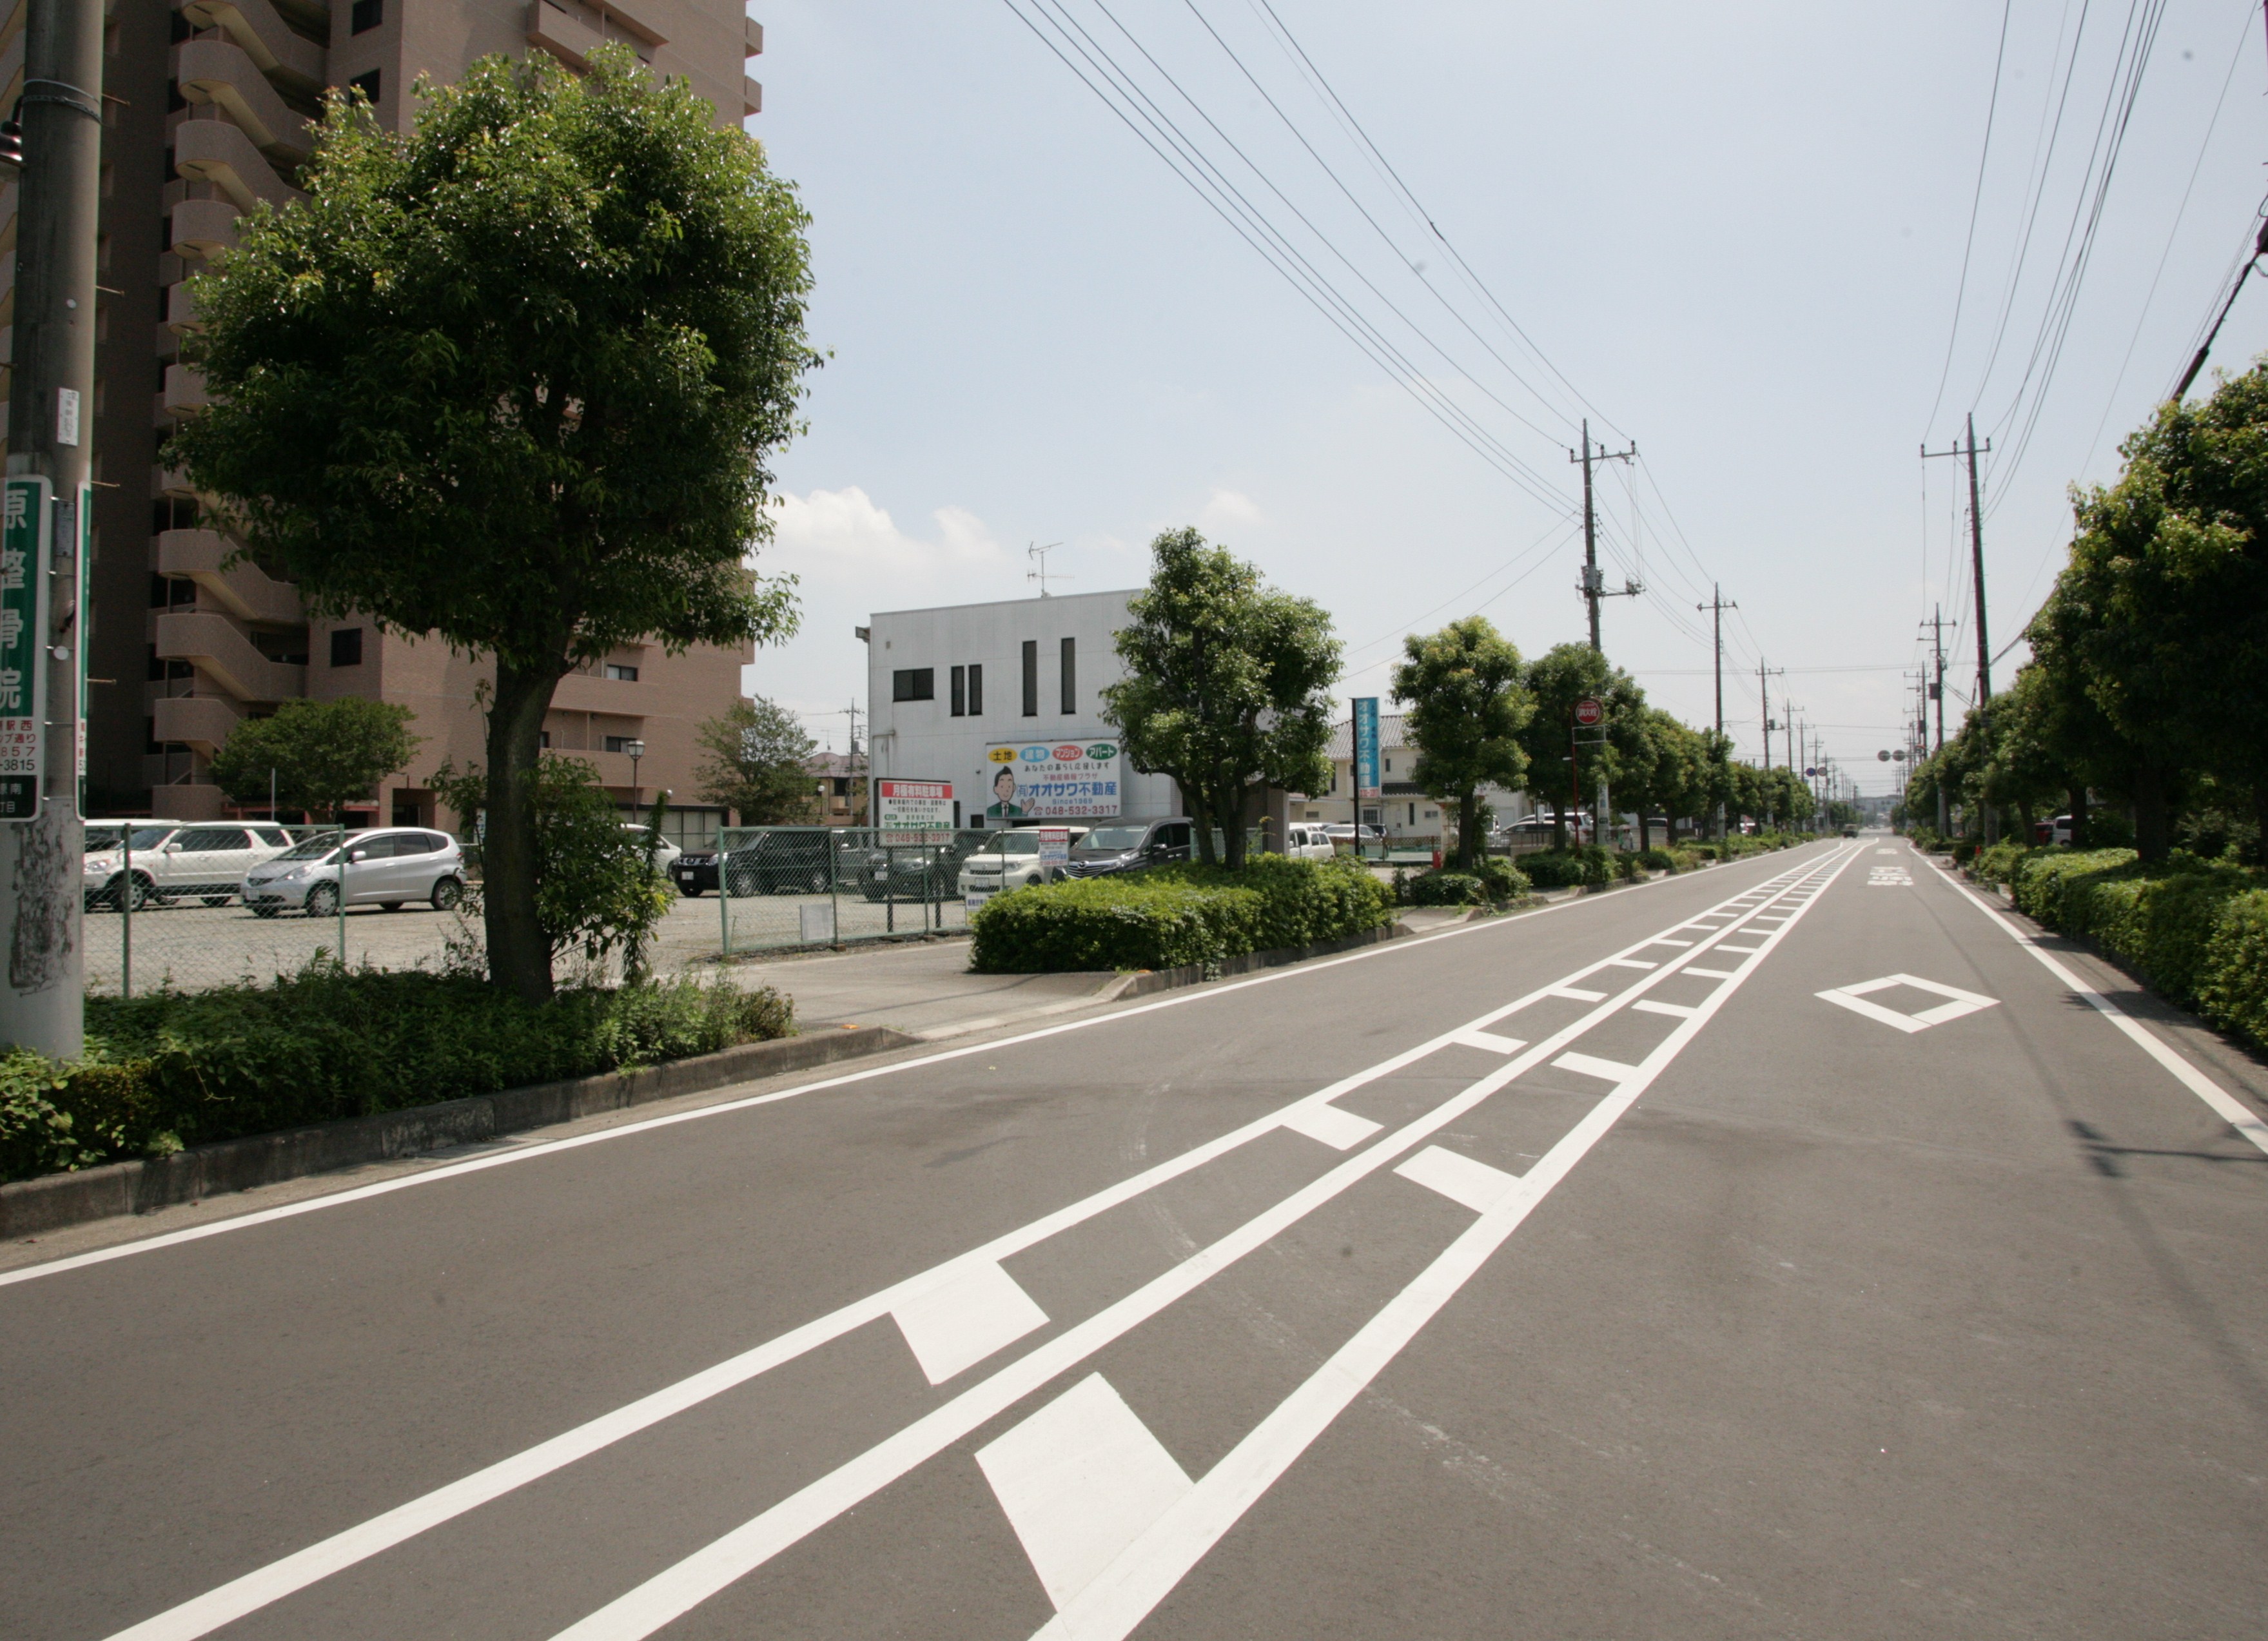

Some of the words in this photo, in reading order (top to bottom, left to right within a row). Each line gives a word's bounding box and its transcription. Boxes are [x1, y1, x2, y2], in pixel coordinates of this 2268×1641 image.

[1358, 700, 1371, 786] オオサワ不動産
[993, 751, 1012, 761] 土地
[1025, 749, 1045, 760] 建物
[1055, 748, 1080, 758] マンション
[1089, 747, 1115, 758] アパート
[1024, 762, 1110, 772] あなたの暮らし応援します
[893, 784, 943, 797] 月極有料駐車場
[1046, 805, 1118, 815] 048-532-3317
[1040, 831, 1068, 840] 月極有料駐車場
